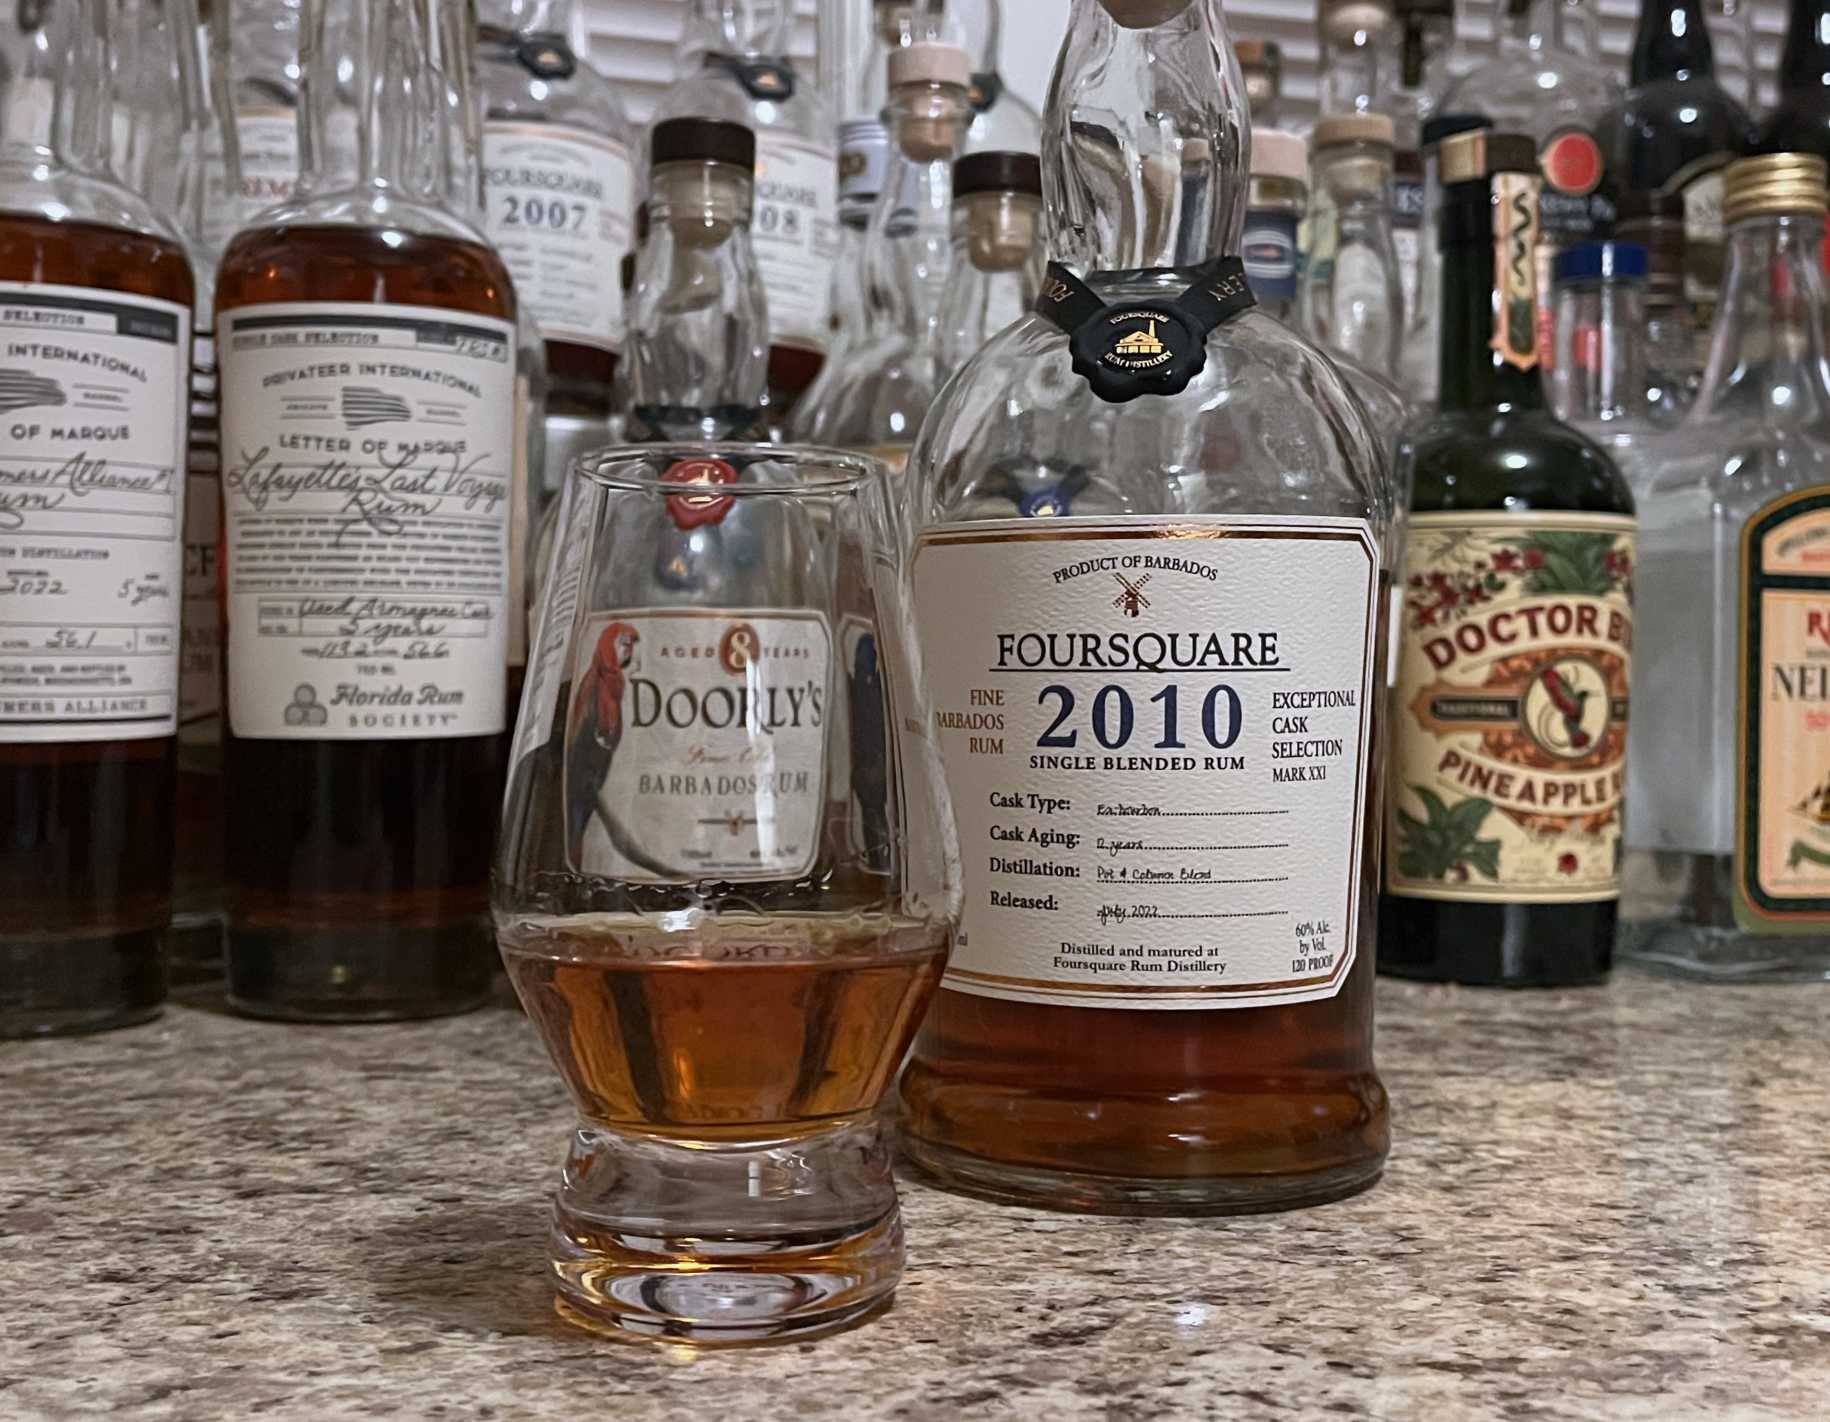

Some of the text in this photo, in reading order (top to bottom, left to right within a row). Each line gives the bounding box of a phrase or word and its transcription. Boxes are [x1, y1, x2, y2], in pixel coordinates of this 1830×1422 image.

[504, 196, 587, 230] 2007
[8, 344, 148, 383] INTERNATIONAL
[262, 362, 482, 399] PRIVATEER INTERNATIONAL
[11, 424, 131, 441] OF MARQUE
[280, 434, 466, 455] LETTER OF MARQUE
[364, 446, 438, 502] Last
[342, 487, 443, 534] Rum
[1052, 555, 1218, 584] PRODUCT OF BARBADOS
[1423, 603, 1598, 671] DOCTOR
[661, 631, 809, 669] AGED 8 YEARS
[997, 632, 1280, 673] FOURSQUARE
[330, 683, 466, 706] Florida Rum
[970, 689, 1005, 706] FINE
[1272, 689, 1357, 709] EXCEPTIONAL
[65, 700, 147, 714] ALLIANCE
[1036, 684, 1243, 750] 2010
[349, 714, 453, 728] SOCIETY
[1272, 716, 1308, 734] CASK
[970, 737, 1004, 755] RUM
[1272, 739, 1343, 759] SELECTION
[1030, 755, 1245, 771] SINGLE BLENDED RUM
[1273, 765, 1326, 782] MARK XXI
[639, 774, 757, 796] BARBADOS
[1438, 750, 1606, 805] PINEAPPLE
[990, 792, 1071, 814] Cask Type:
[990, 825, 1080, 849] Cask Aging:
[990, 857, 1080, 878] Distillation:
[1097, 866, 1114, 879] Pot
[990, 890, 1058, 911] Released:
[1131, 904, 1158, 918] 2022
[1295, 921, 1315, 937] 60%
[1060, 942, 1219, 958] Distilled and matured at
[1299, 940, 1309, 957] by
[1053, 956, 1227, 975] Foursquare Rum Distillery
[1292, 954, 1333, 973] 120 PROOF
